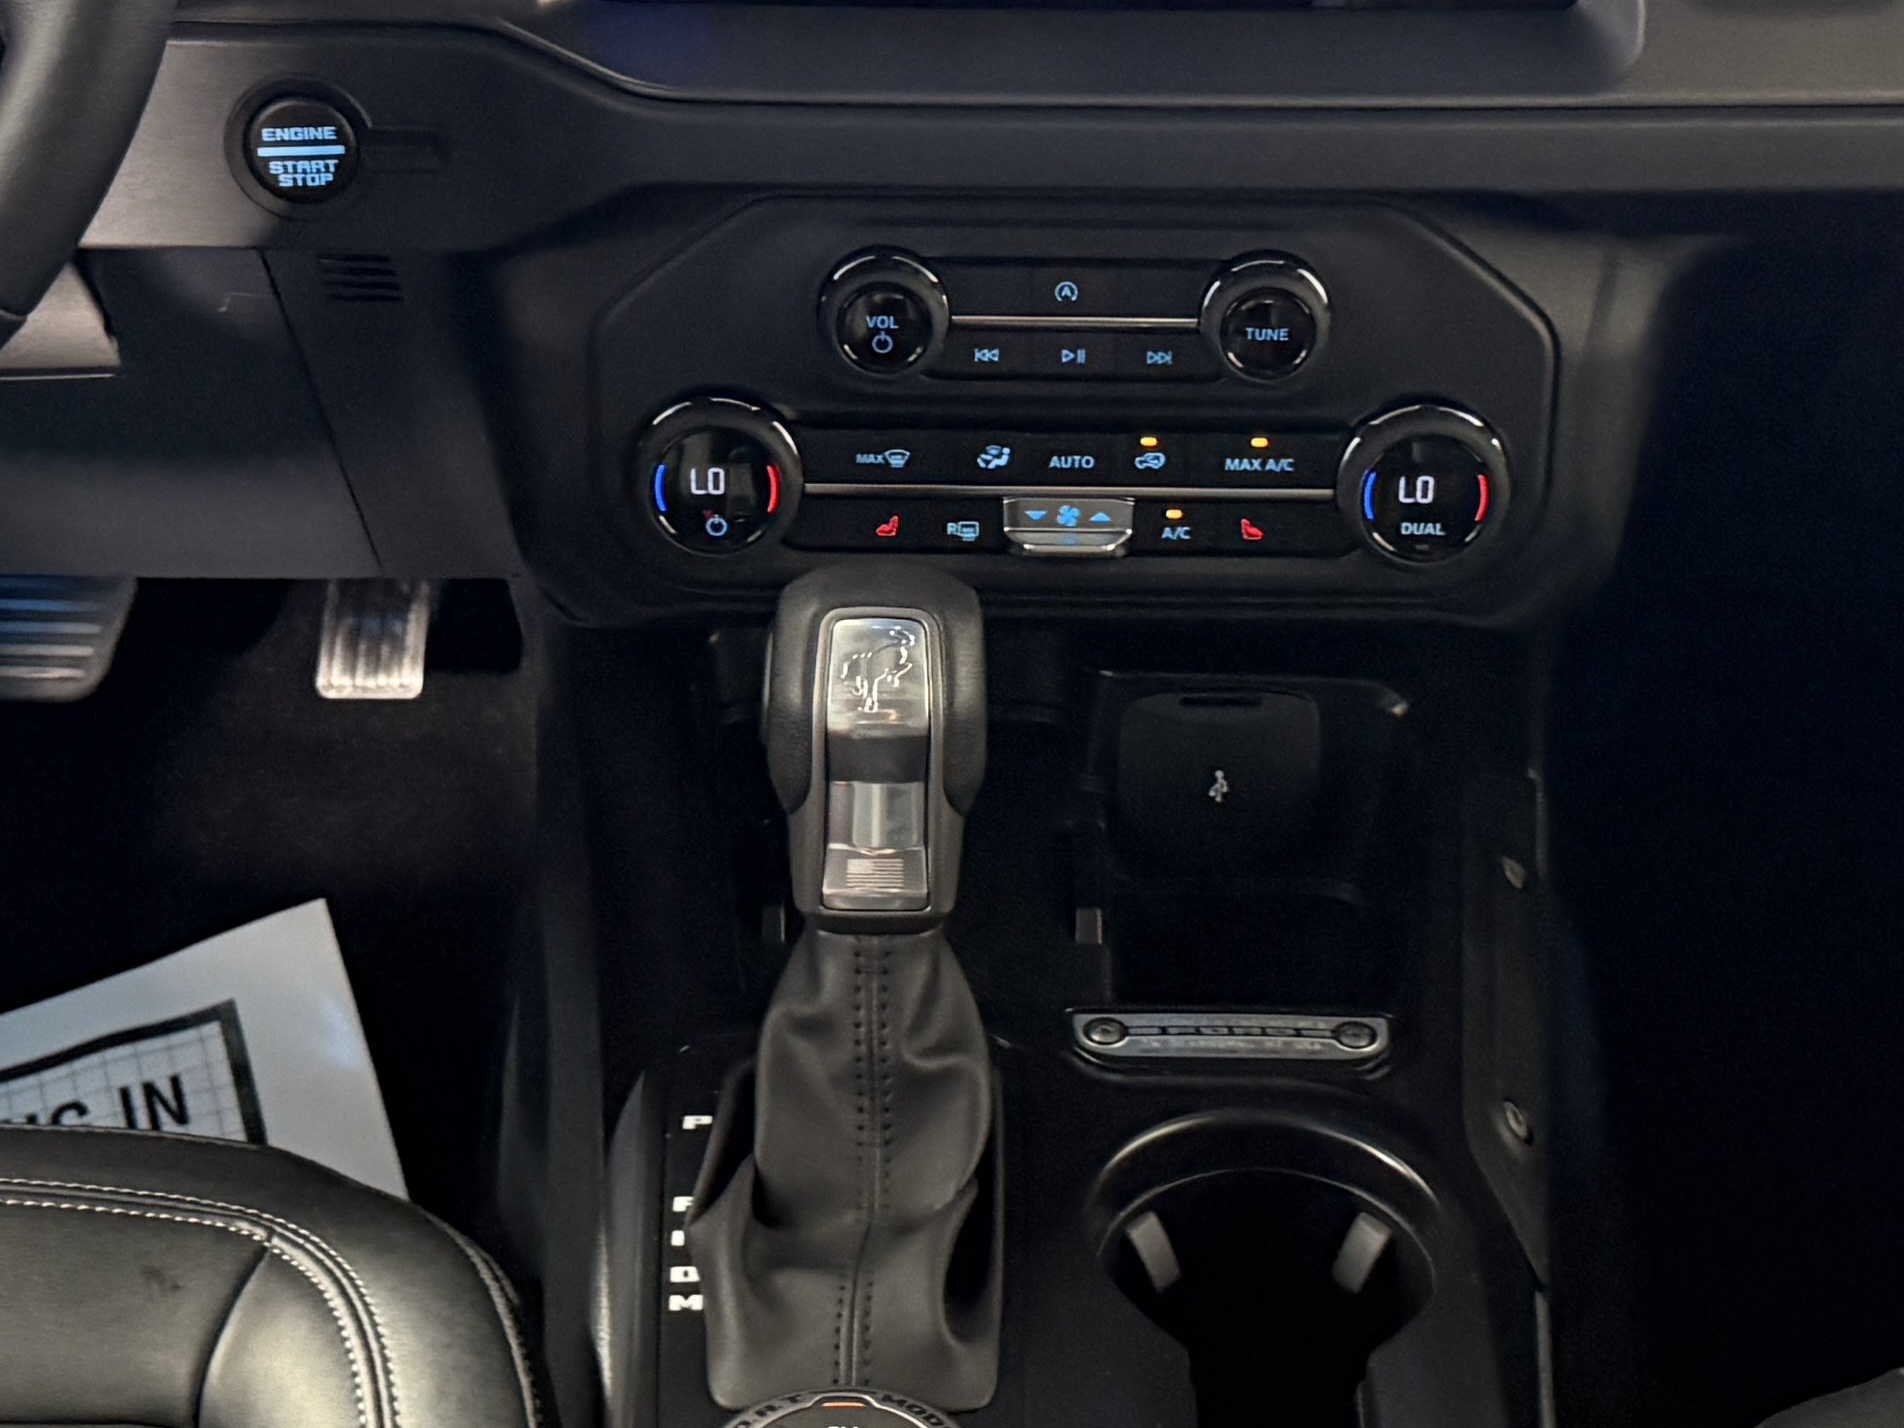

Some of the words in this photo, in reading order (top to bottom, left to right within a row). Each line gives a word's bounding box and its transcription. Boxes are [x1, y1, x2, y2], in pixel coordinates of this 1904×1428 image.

[261, 126, 338, 142] ENGINE
[268, 159, 339, 174] START
[277, 173, 334, 188] STOP
[865, 315, 899, 330] VOL
[1244, 326, 1290, 343] TUNE
[855, 453, 884, 466] MAX
[1049, 455, 1096, 470] AUTO
[1224, 457, 1263, 472] MAX
[1264, 457, 1295, 473] A/C
[690, 468, 726, 496] LO
[1397, 475, 1435, 504] LO
[1161, 525, 1192, 541] A/C
[1400, 521, 1446, 537] DUAL
[119, 1074, 191, 1132] IN
[668, 1294, 704, 1311] M
